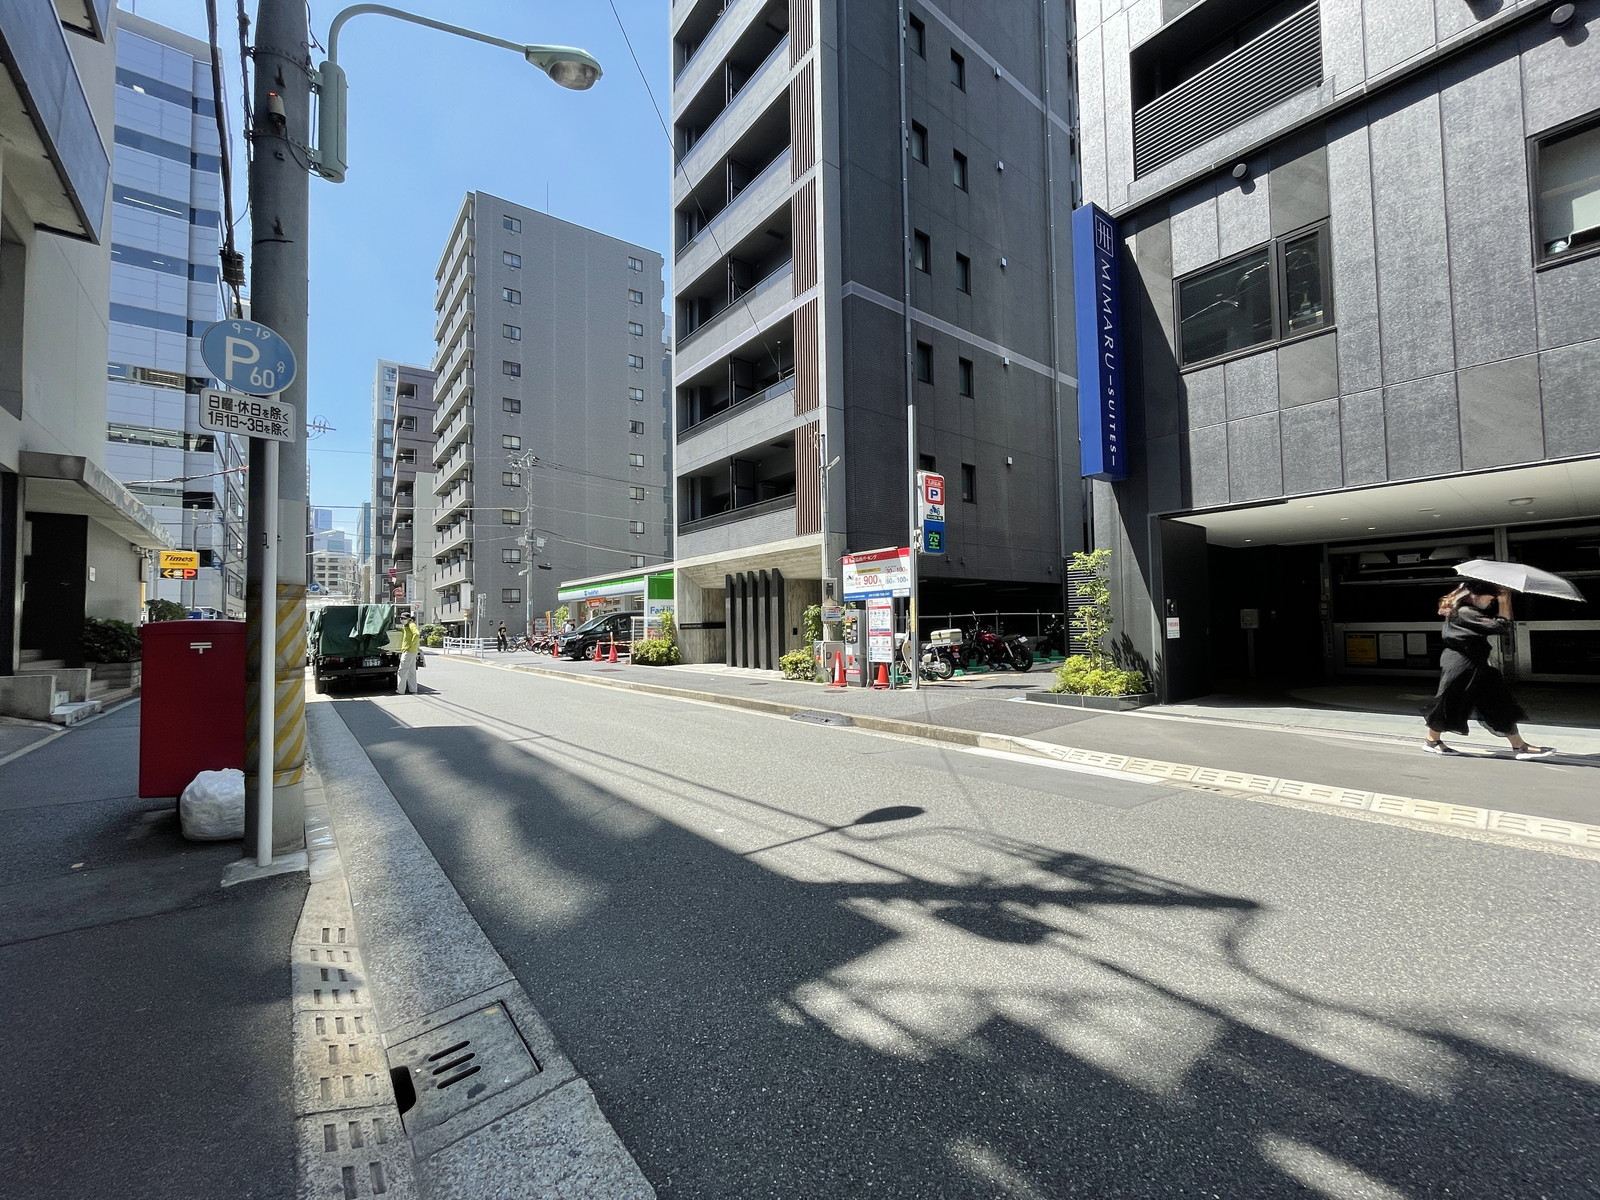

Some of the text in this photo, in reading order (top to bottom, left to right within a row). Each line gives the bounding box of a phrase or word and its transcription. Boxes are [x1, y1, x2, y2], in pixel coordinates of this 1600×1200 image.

[1098, 258, 1116, 370] MIMARU
[232, 322, 271, 340] 9-19
[224, 335, 260, 381] P
[930, 489, 939, 499] P
[164, 554, 194, 562] Times
[863, 574, 878, 586] 900
